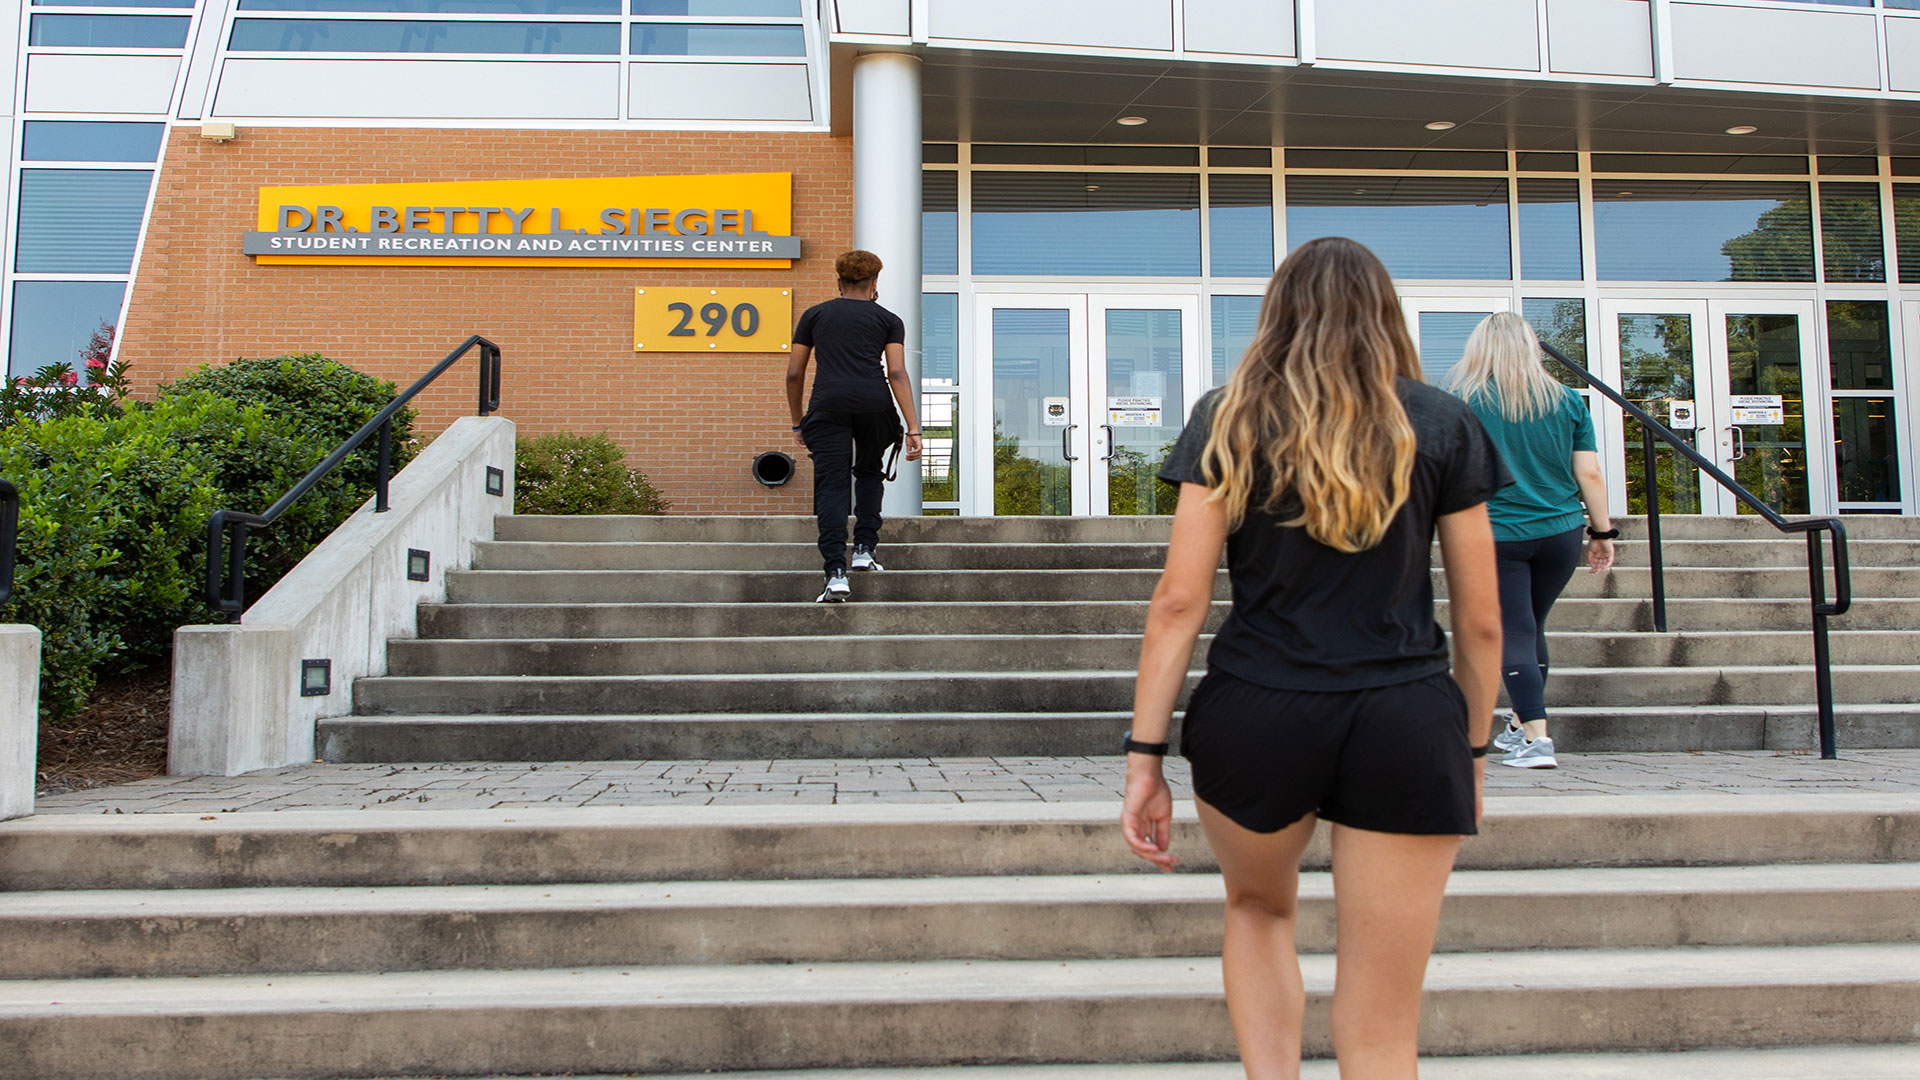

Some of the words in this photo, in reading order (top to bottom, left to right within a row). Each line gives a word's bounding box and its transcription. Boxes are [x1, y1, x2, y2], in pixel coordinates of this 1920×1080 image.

[277, 205, 357, 233] DR.
[371, 206, 535, 234] BETTY
[550, 207, 587, 235] L.
[600, 208, 768, 236] SIEGEL
[270, 237, 371, 249] STUDENT
[378, 238, 511, 250] RECREATION
[517, 239, 563, 251] AND
[568, 239, 685, 252] ACTIVITIES
[691, 240, 774, 253] CENTER
[667, 302, 760, 337] 290
